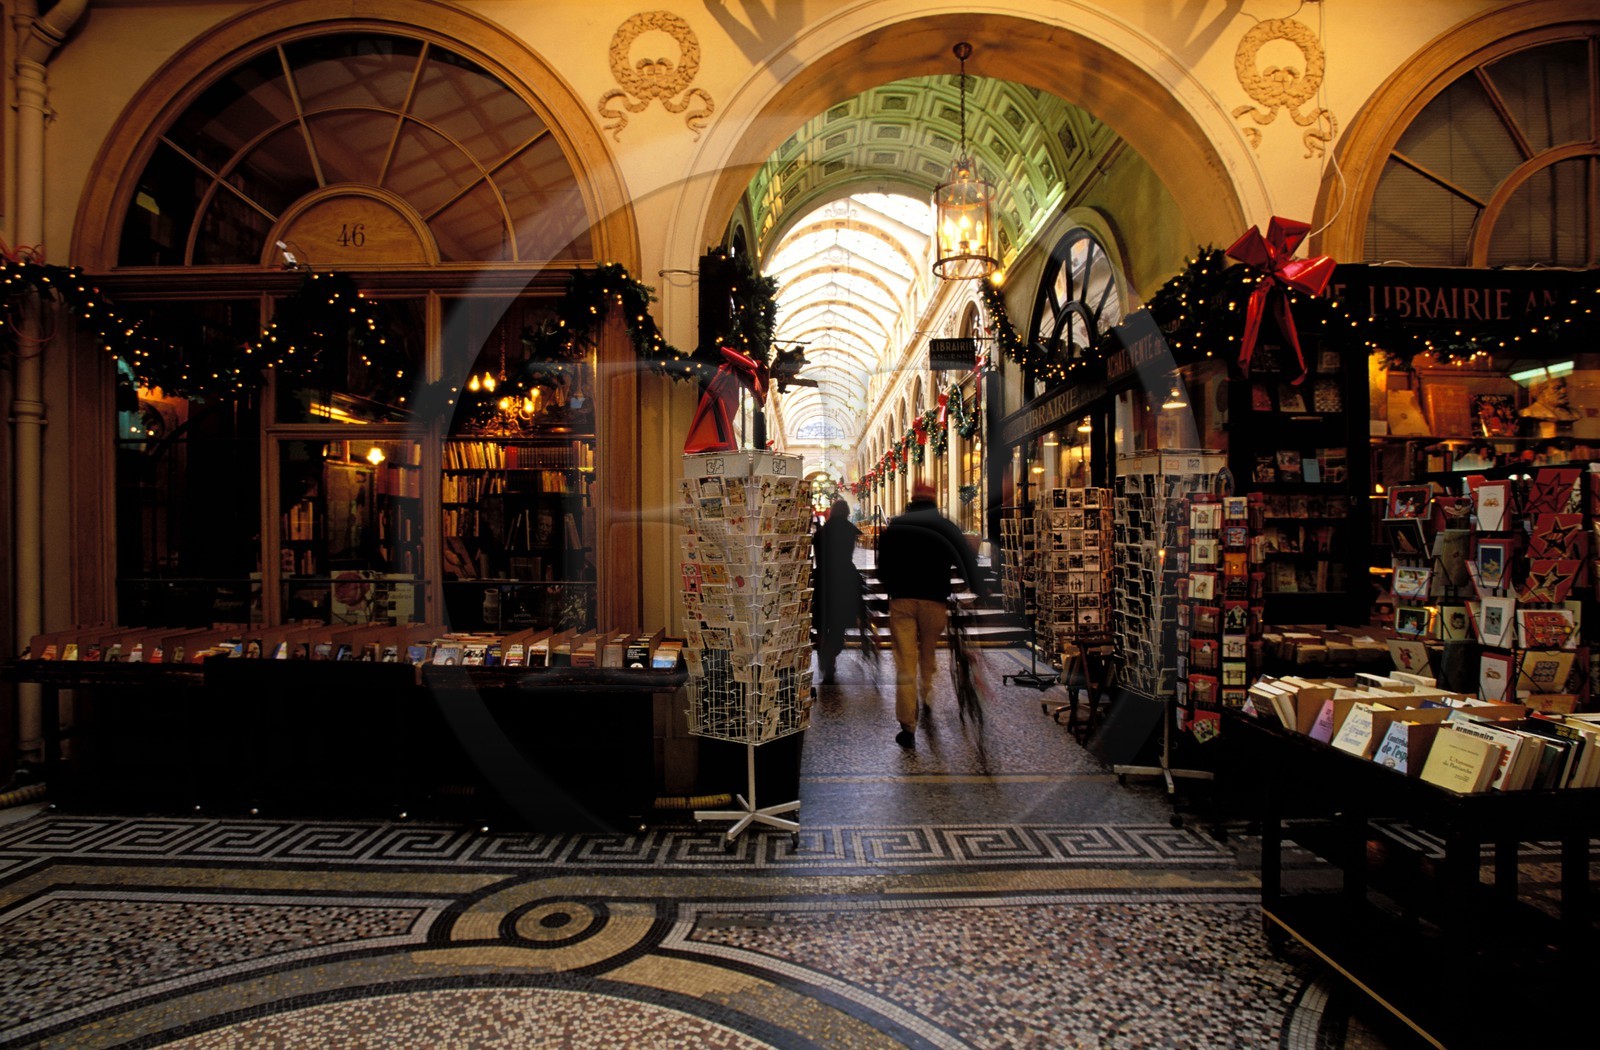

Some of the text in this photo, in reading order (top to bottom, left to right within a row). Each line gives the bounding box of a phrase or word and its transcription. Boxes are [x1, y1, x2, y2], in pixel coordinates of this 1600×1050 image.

[336, 223, 366, 248] 46
[1368, 284, 1513, 321] LIBRAIRIE
[931, 341, 974, 352] LIBRAIRIE
[1023, 386, 1079, 433] LIBRAIRIE
[1381, 741, 1392, 755] de
